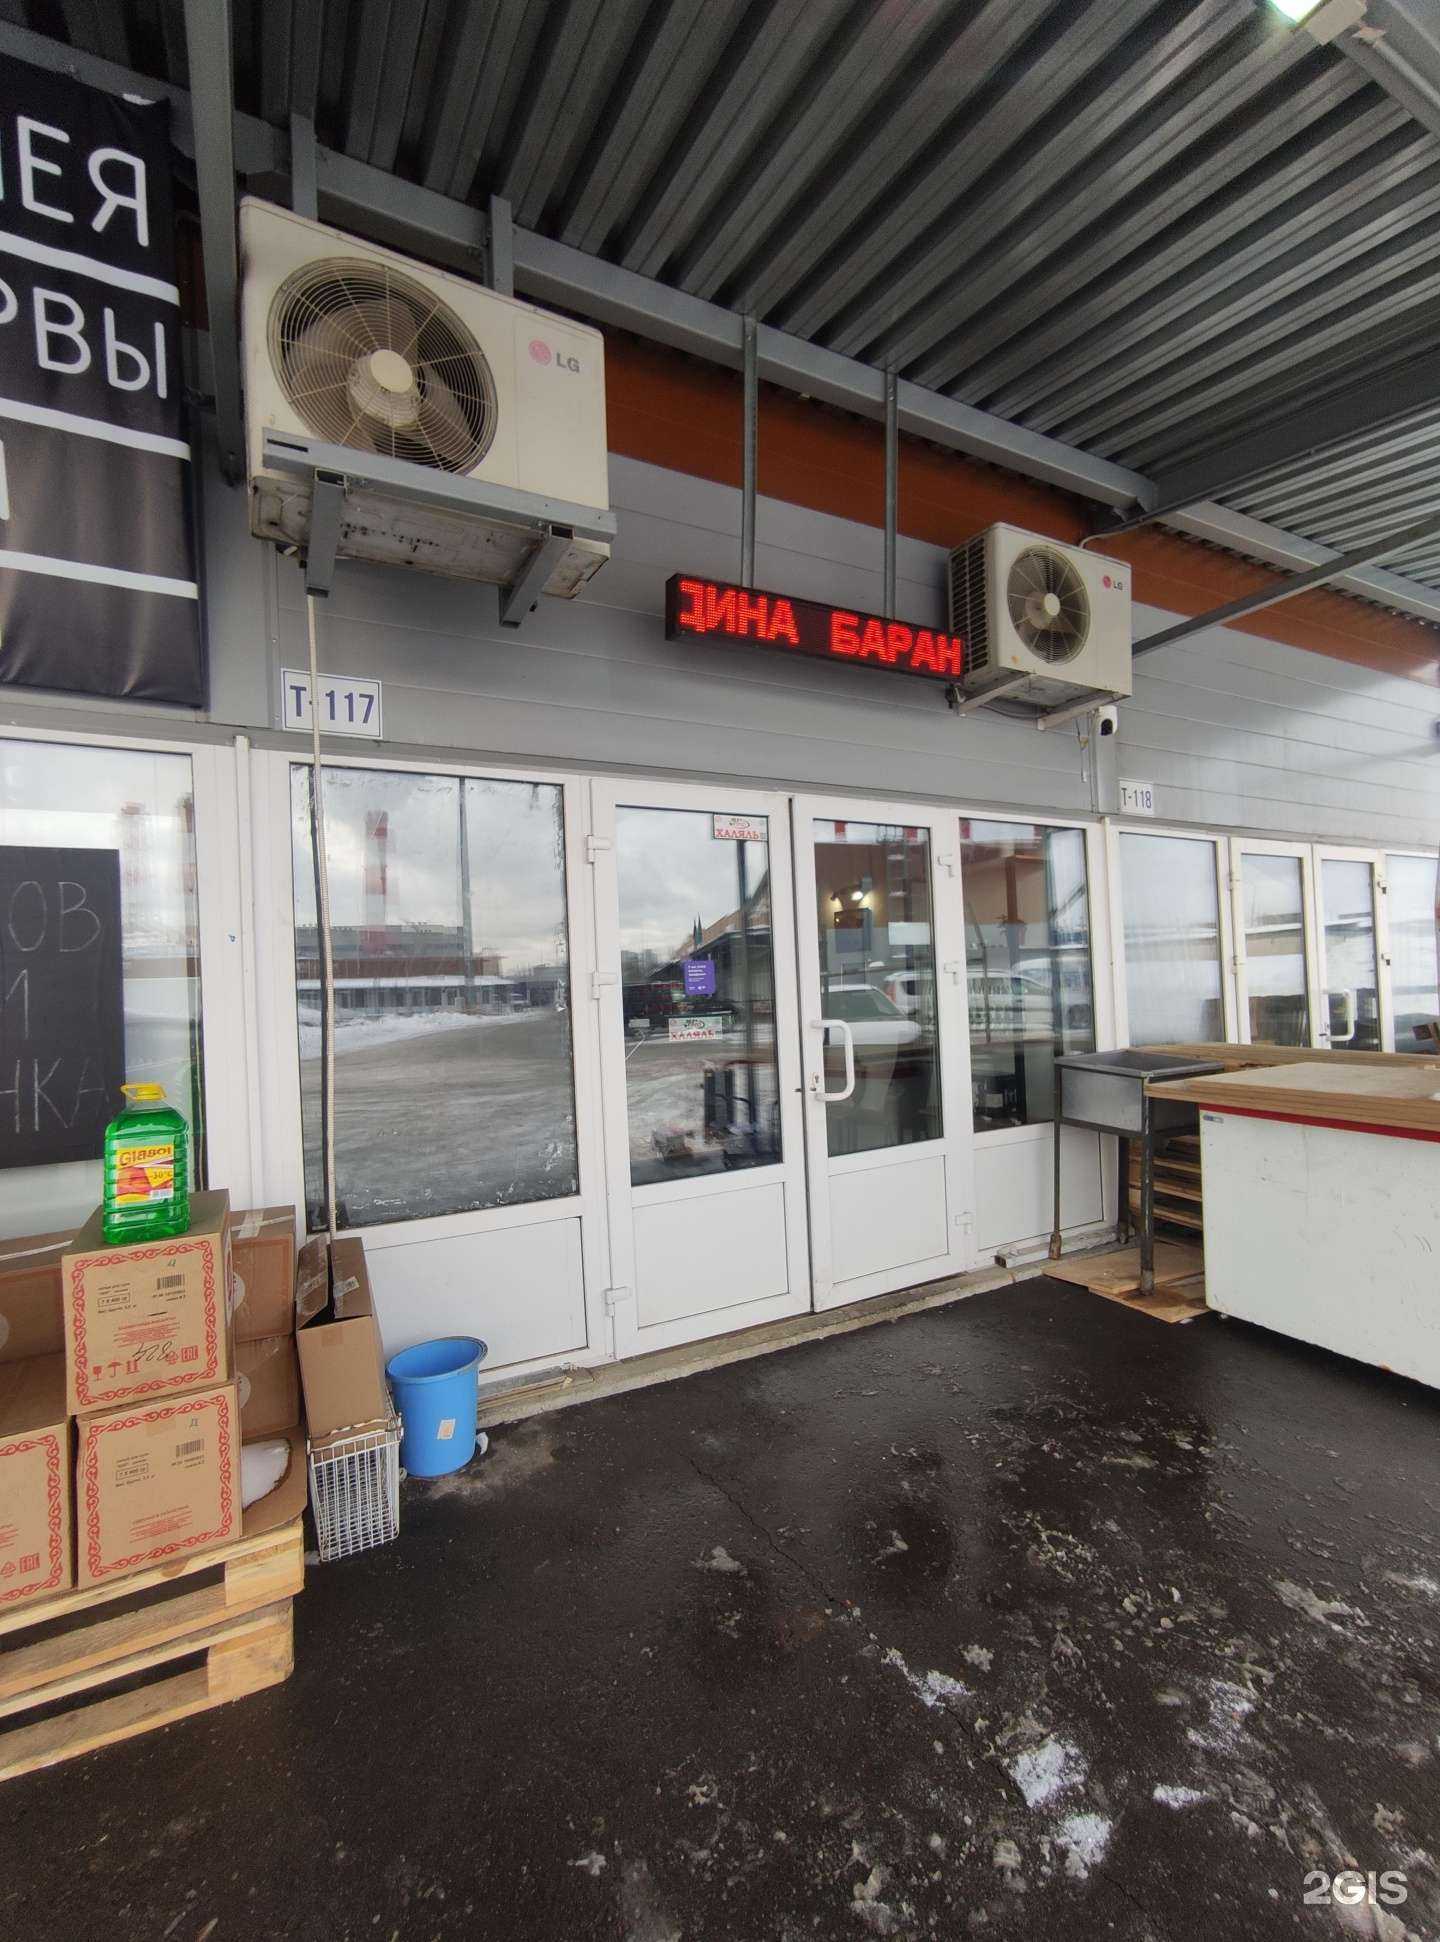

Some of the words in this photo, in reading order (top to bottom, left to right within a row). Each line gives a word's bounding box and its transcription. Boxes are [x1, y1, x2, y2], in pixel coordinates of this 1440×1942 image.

[0, 115, 149, 247] ЕЯ
[557, 352, 580, 373] LG
[1113, 580, 1123, 591] LG
[830, 610, 961, 675] БАРАН
[716, 828, 760, 840] ХАЛЯЛЬ
